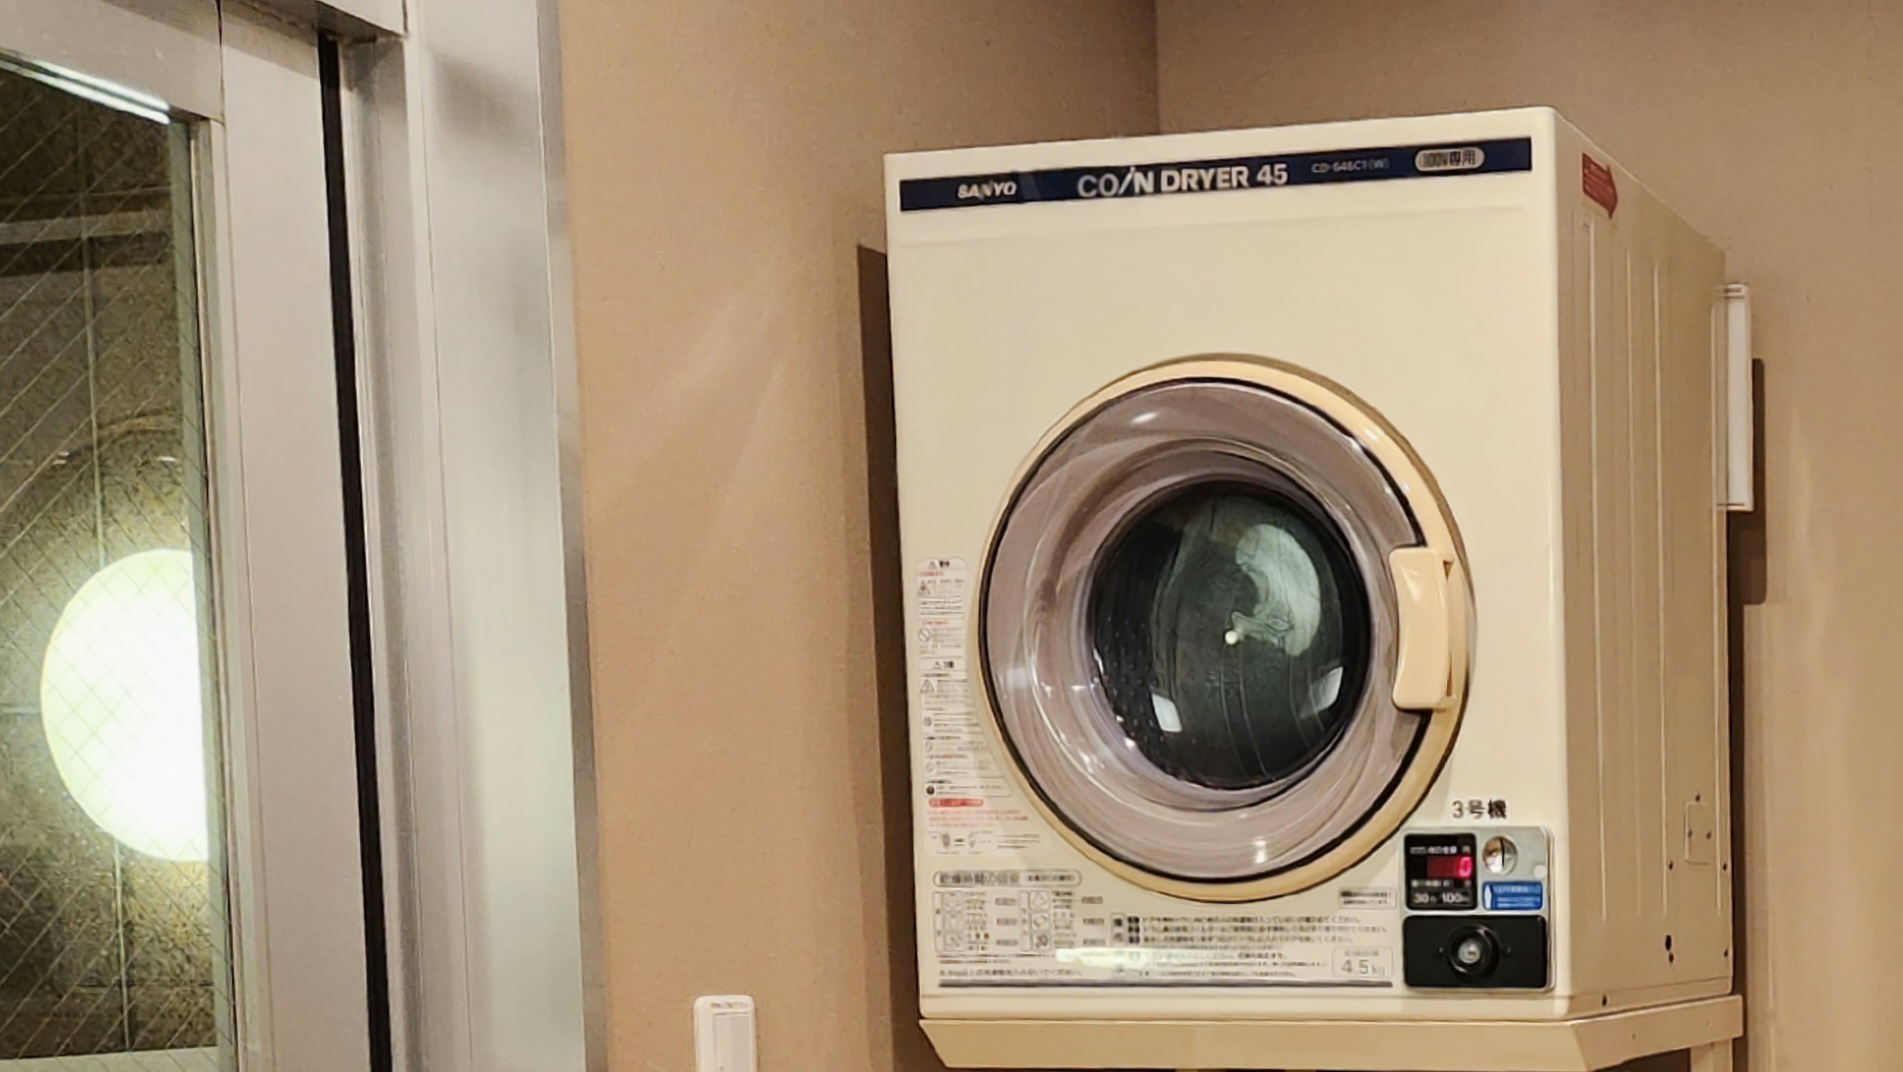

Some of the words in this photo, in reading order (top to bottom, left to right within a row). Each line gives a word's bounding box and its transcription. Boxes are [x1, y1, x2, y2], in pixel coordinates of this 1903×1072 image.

[957, 181, 1017, 200] SANYO
[1078, 166, 1154, 198] COIN
[1160, 166, 1249, 193] DRYER
[1256, 163, 1289, 186] 45
[1452, 799, 1508, 820] 3号機
